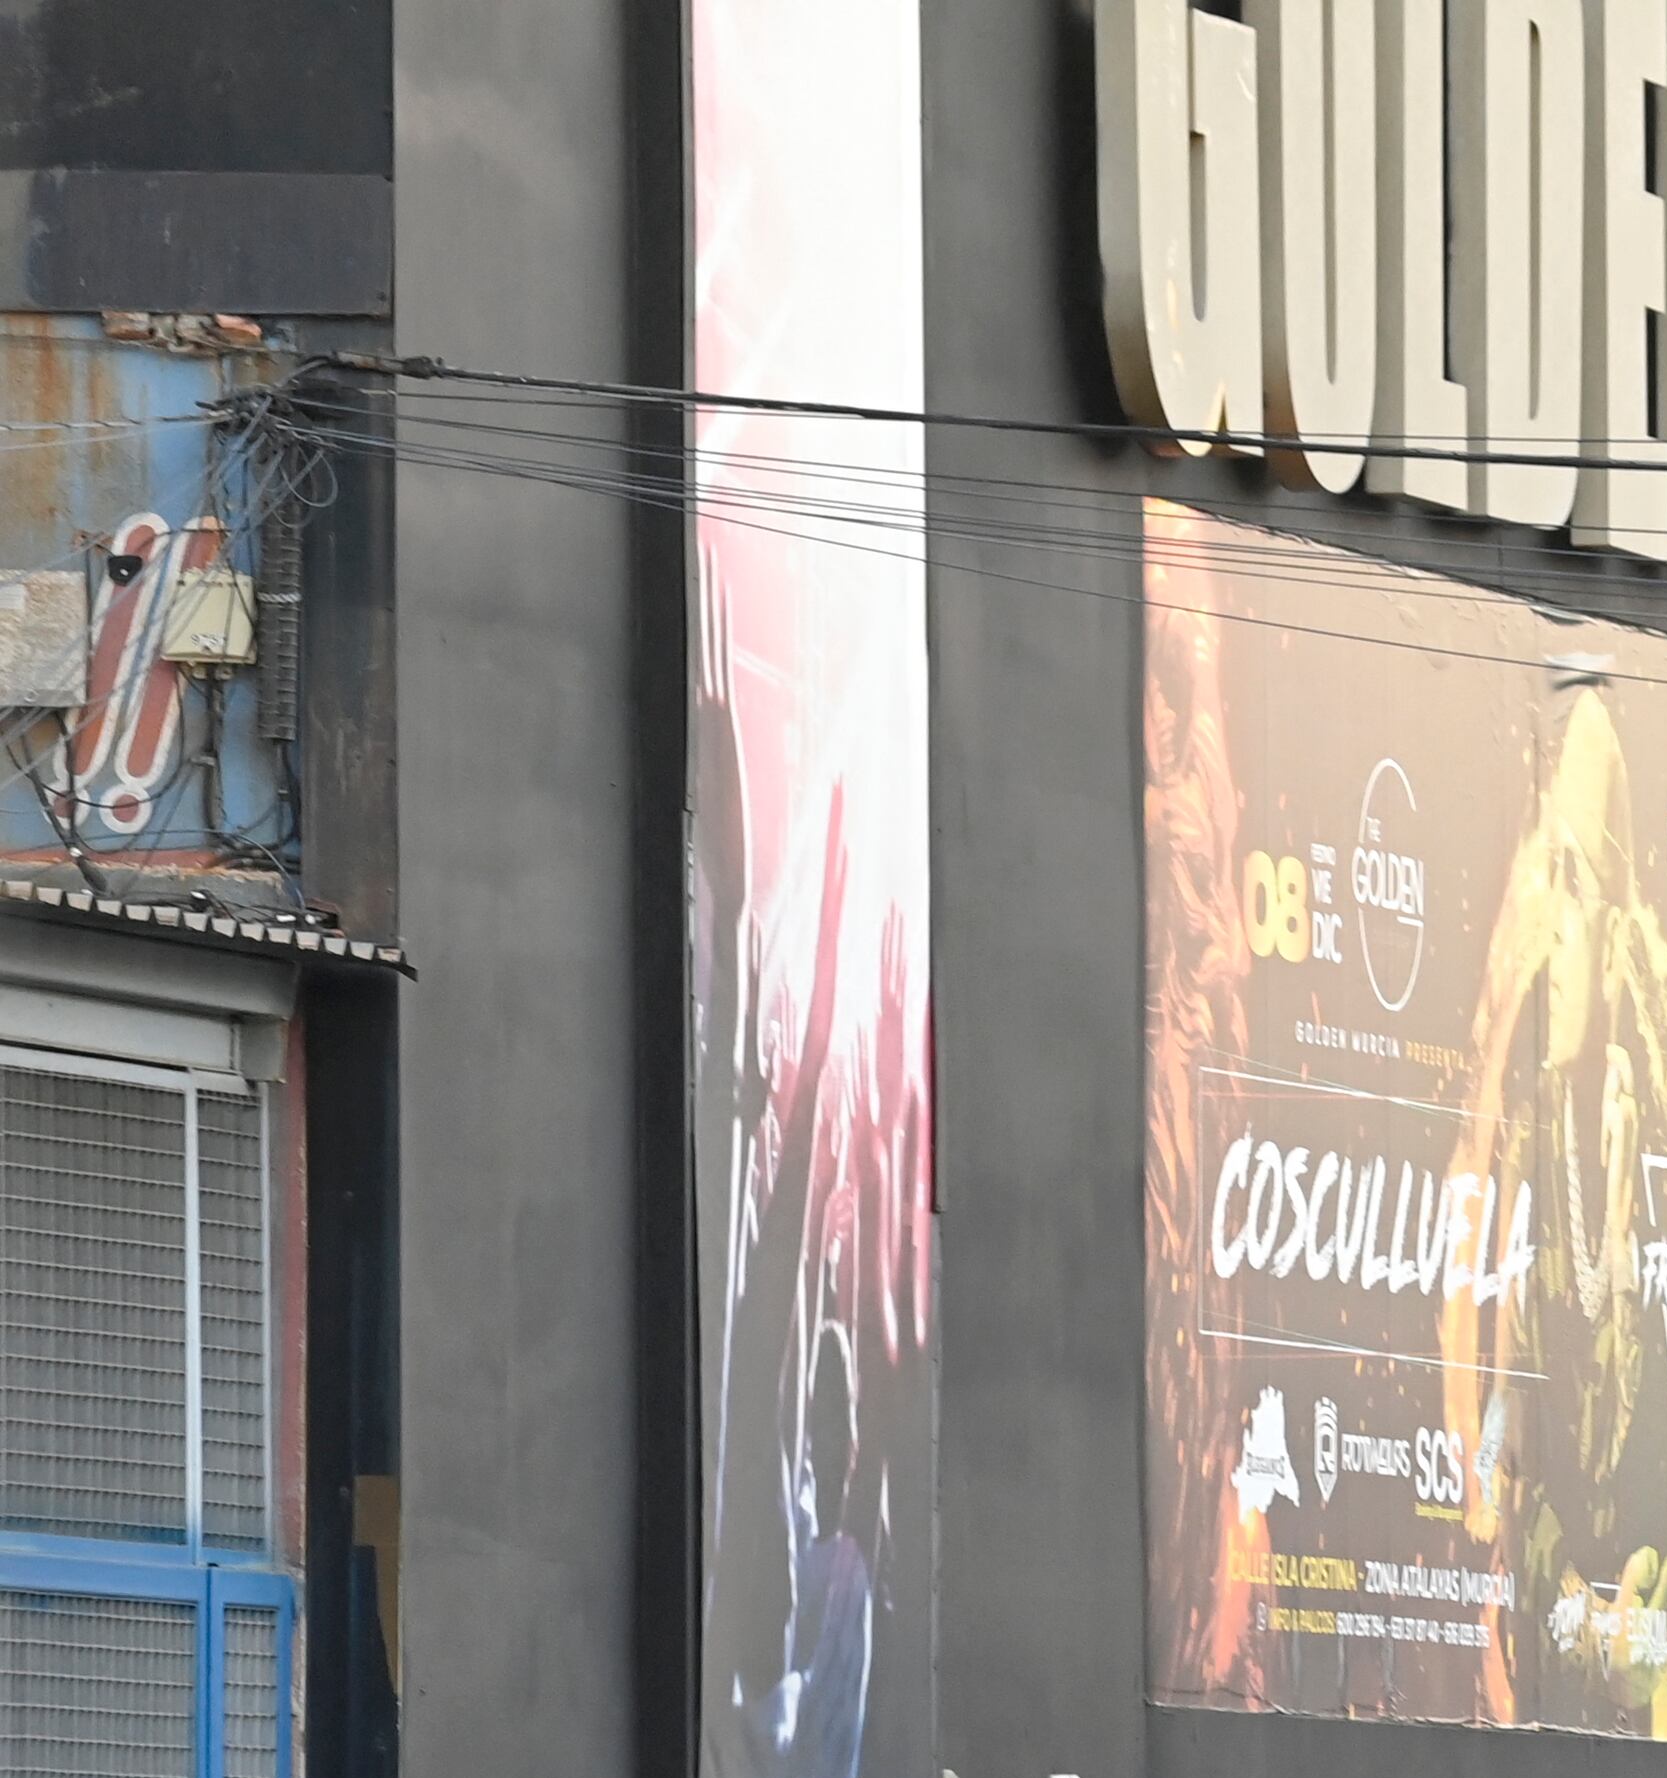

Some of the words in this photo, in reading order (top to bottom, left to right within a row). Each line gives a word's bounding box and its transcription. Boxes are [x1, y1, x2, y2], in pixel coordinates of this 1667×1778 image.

[1243, 850, 1311, 963] 08
[1352, 846, 1424, 916] GOLDEN
[1312, 911, 1343, 964] DIC
[1295, 1019, 1347, 1049] GOLDEN
[1352, 1028, 1400, 1058] MURCIA
[1211, 1124, 1535, 1313] COSCULLUELA
[1415, 1426, 1463, 1504] SCS
[1272, 1553, 1299, 1588] ISLA
[1300, 1555, 1358, 1592] CRISTINA
[1364, 1560, 1398, 1596] ZONA
[1400, 1563, 1460, 1602] ATALAYAS
